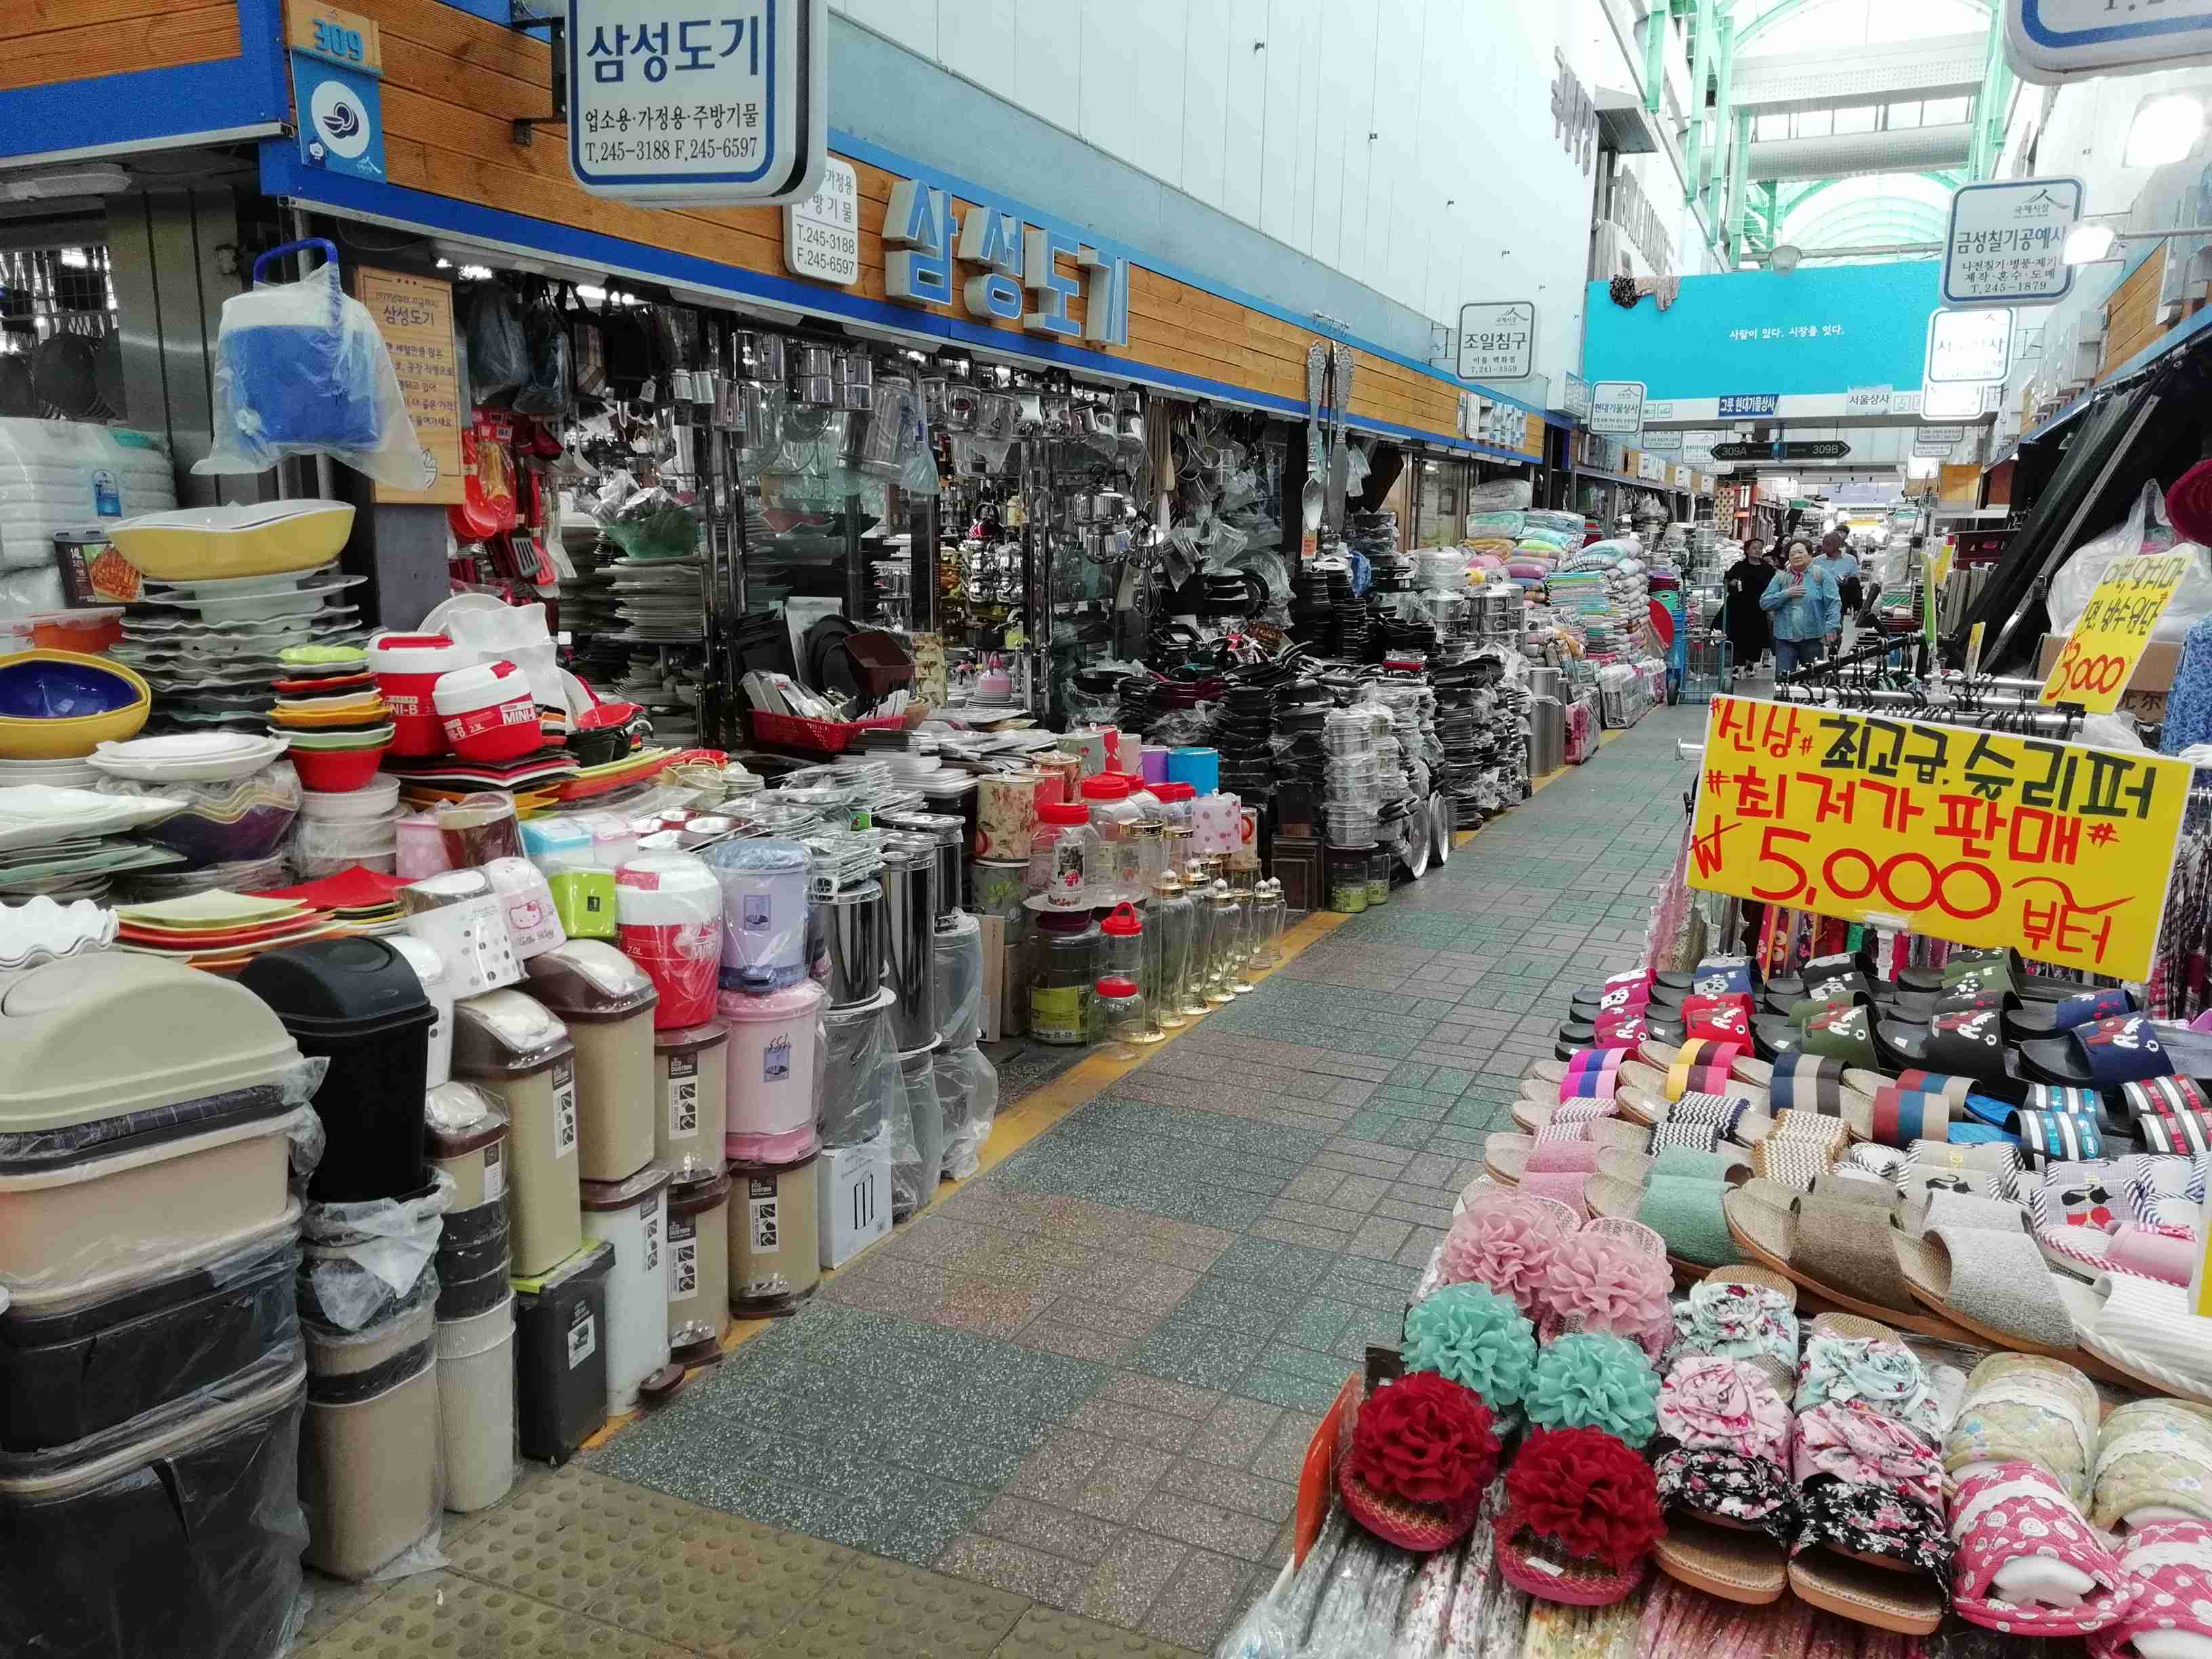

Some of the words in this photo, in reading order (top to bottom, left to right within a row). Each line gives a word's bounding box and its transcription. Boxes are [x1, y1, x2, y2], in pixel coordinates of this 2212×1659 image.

[313, 18, 364, 62] 309
[586, 15, 758, 83] 삼성도기
[586, 140, 670, 163] T.245-3188
[674, 137, 758, 162] F.245-6597
[1957, 226, 2067, 254] 금성칠기공예사
[882, 179, 1128, 346] 삼성도기
[1971, 281, 2047, 293] T.245-1879
[384, 304, 434, 327] 삼성도기
[1463, 332, 1528, 351] 조일침구
[1729, 328, 1758, 340] 사람이
[1789, 325, 1818, 337] 시장을
[1722, 447, 1747, 456] 309A
[1812, 444, 1839, 455] 309B
[1963, 733, 2157, 820] 슬리퍼
